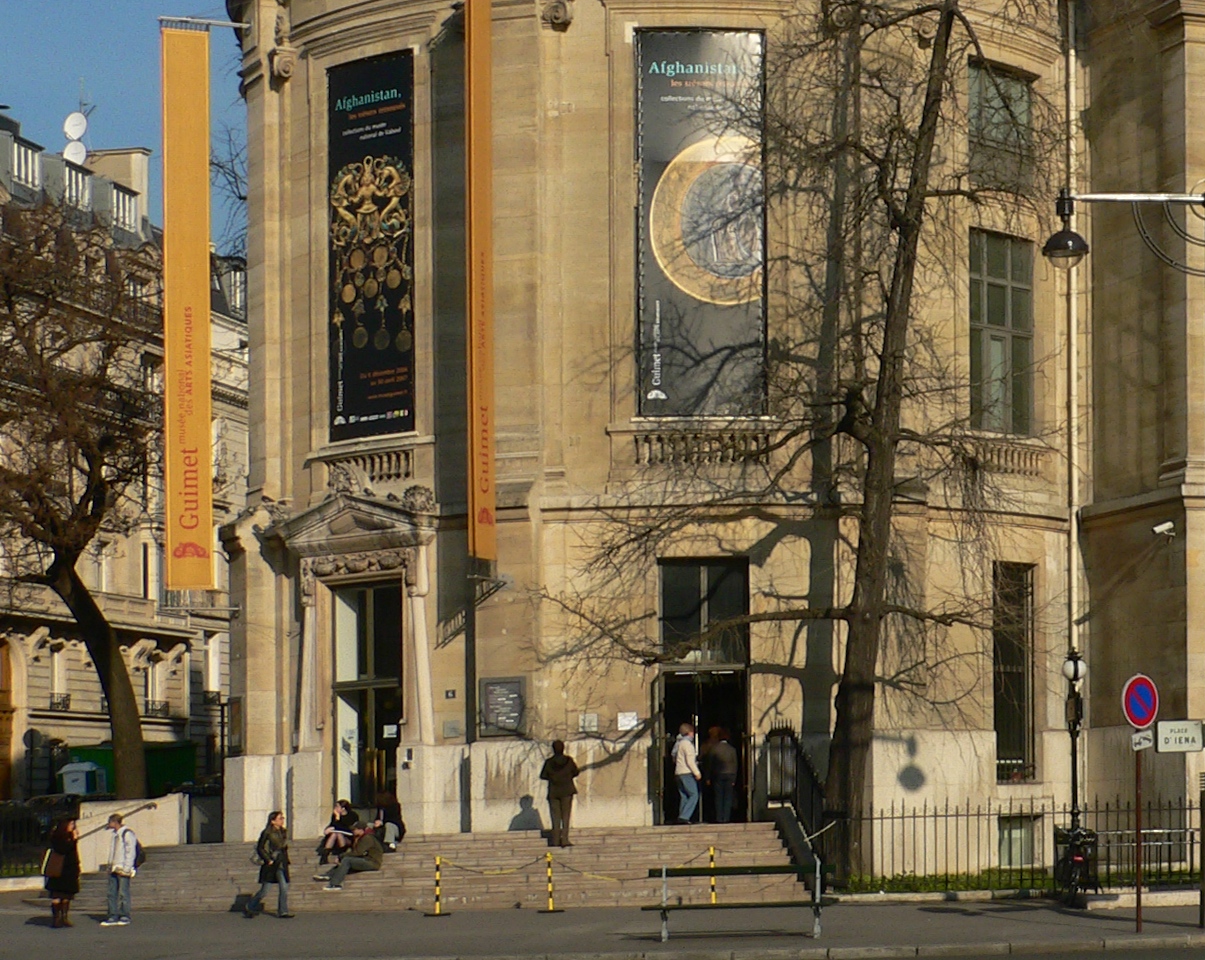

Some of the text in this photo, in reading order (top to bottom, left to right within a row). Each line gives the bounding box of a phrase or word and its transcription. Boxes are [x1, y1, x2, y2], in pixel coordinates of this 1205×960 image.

[335, 88, 402, 111] Afghanistan,
[184, 306, 193, 366] ASIATIQUES
[184, 370, 193, 395] ARTS
[651, 354, 661, 386] Guimet
[177, 412, 186, 444] musée
[480, 406, 490, 493] Guimet
[179, 447, 199, 530] Guimet
